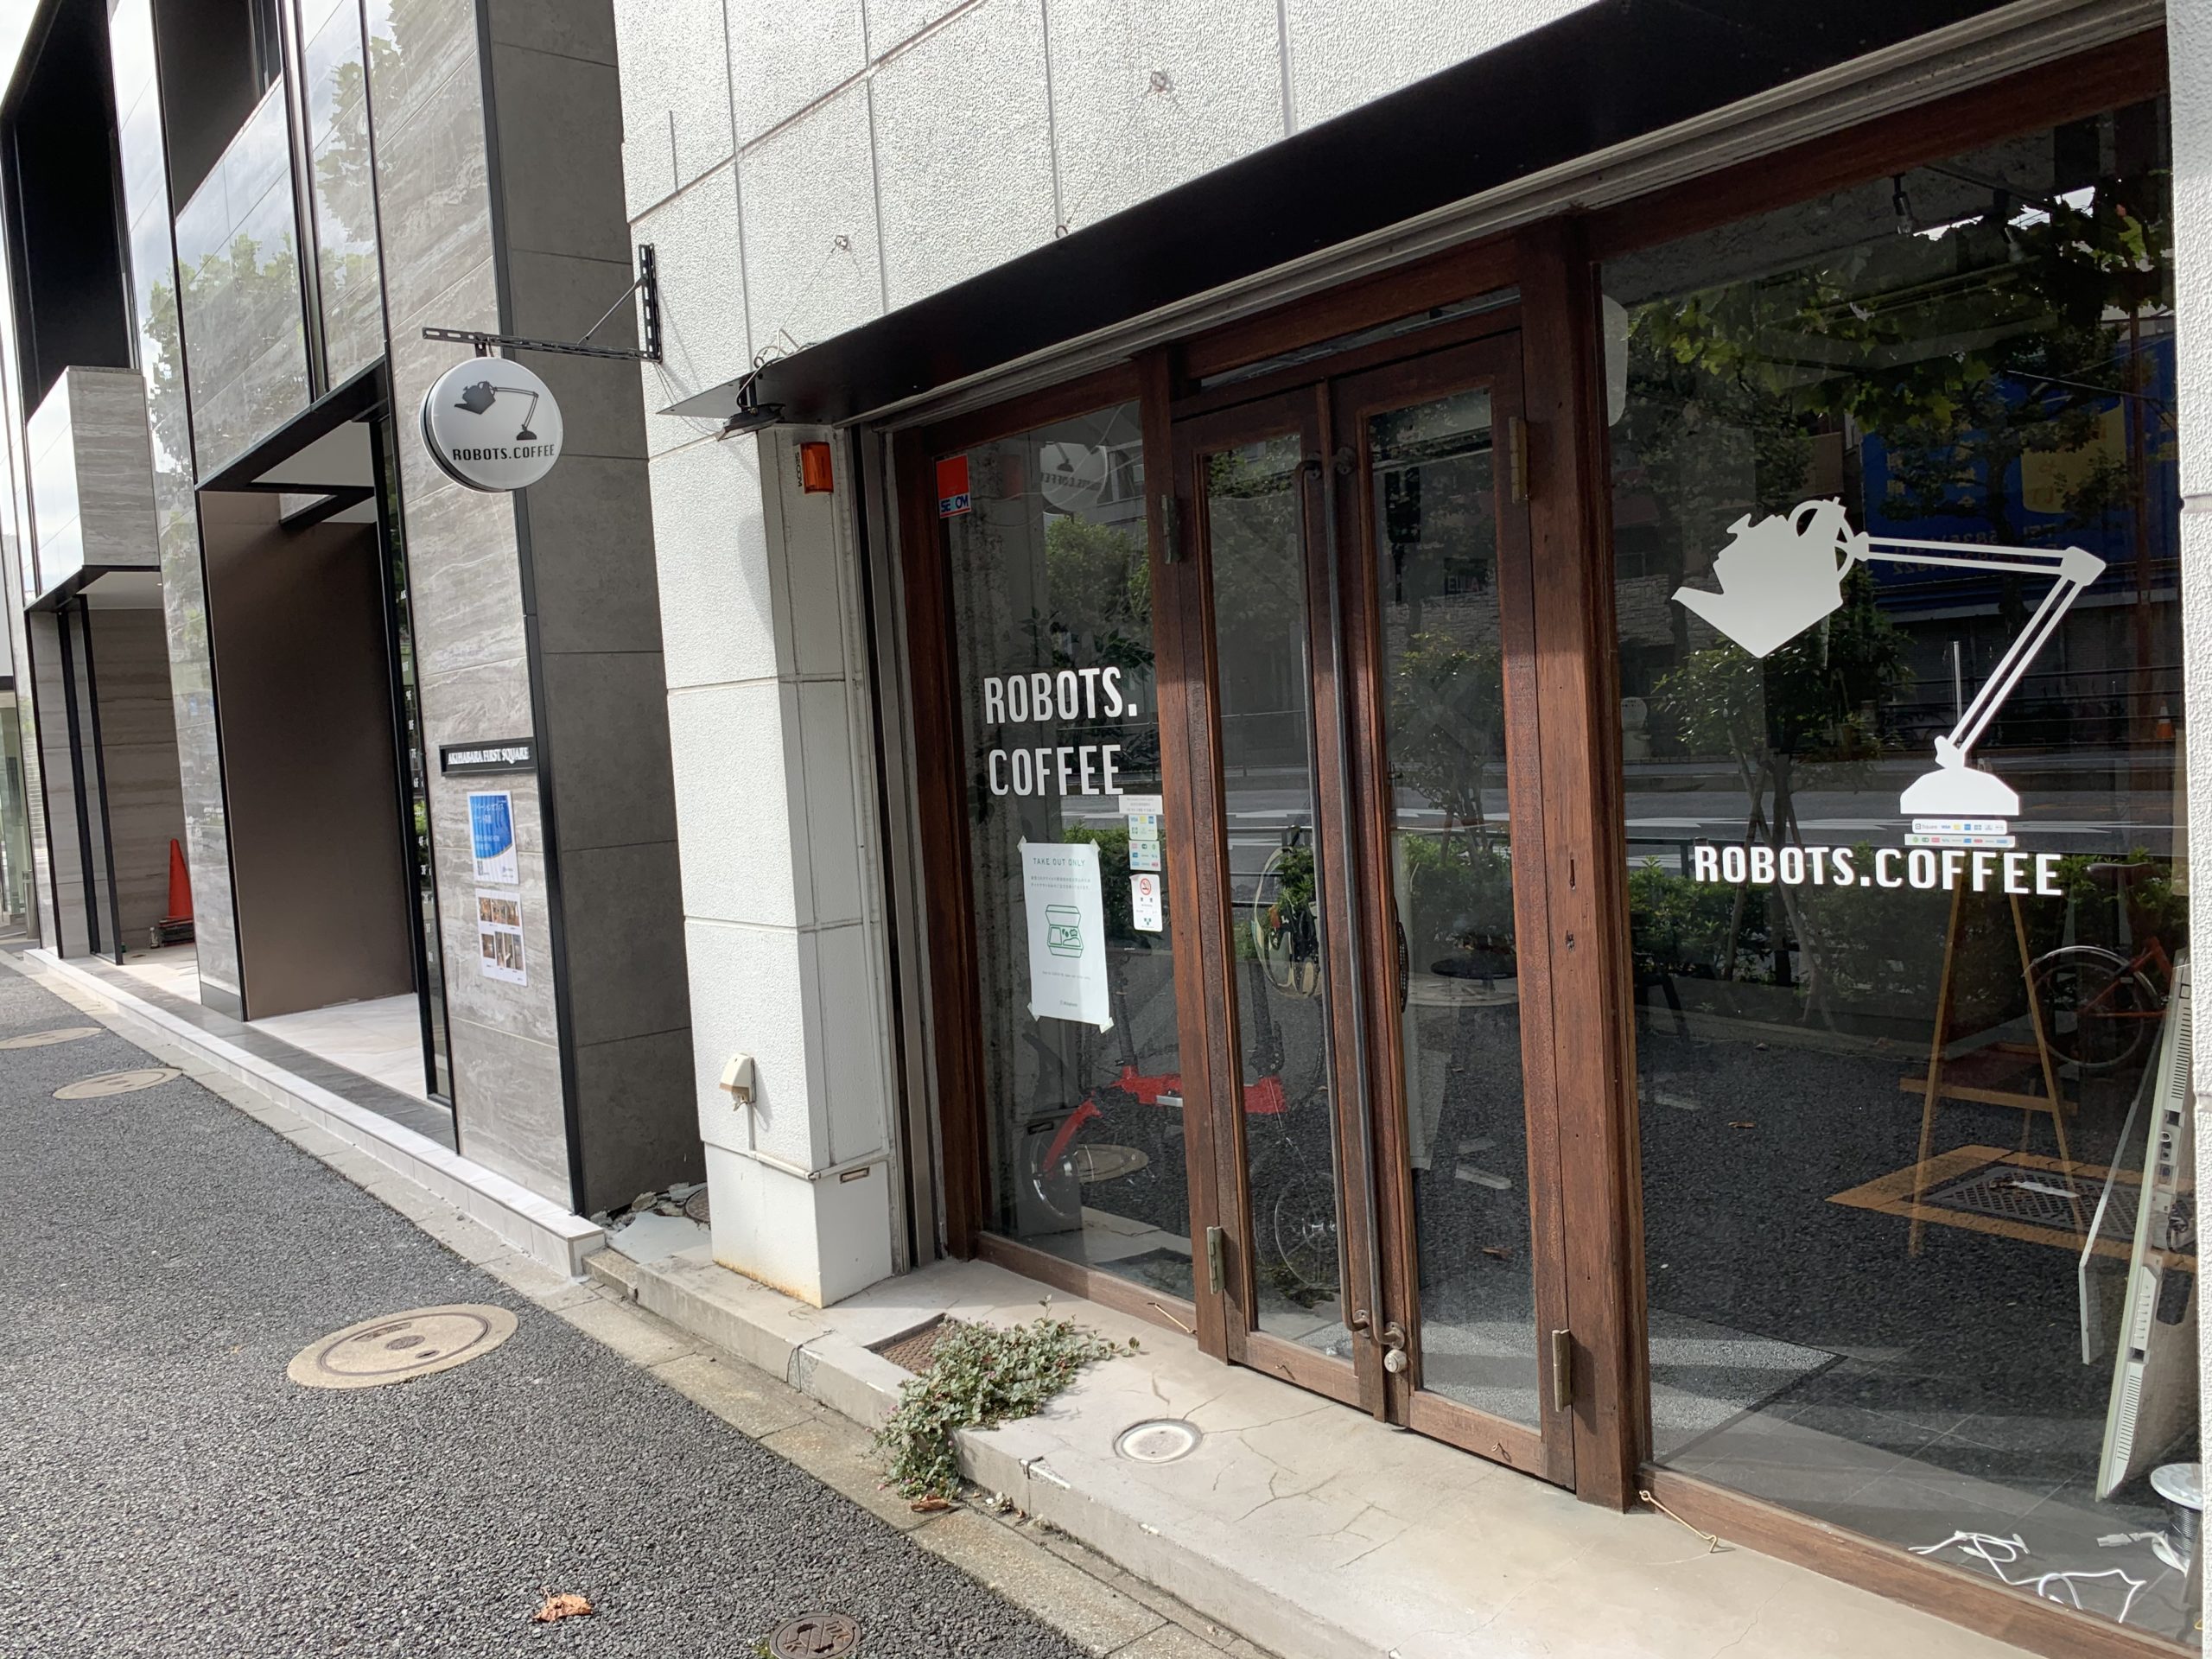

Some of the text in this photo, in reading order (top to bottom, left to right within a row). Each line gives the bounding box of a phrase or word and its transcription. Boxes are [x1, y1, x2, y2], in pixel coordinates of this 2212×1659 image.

[453, 444, 555, 461] ROBOTS.COFFEE
[941, 495, 969, 512] SEOM
[984, 666, 1138, 724] ROBOTS.
[988, 744, 1123, 796] COFFEE
[1694, 846, 2063, 896] ROBOTS.COFFEE
